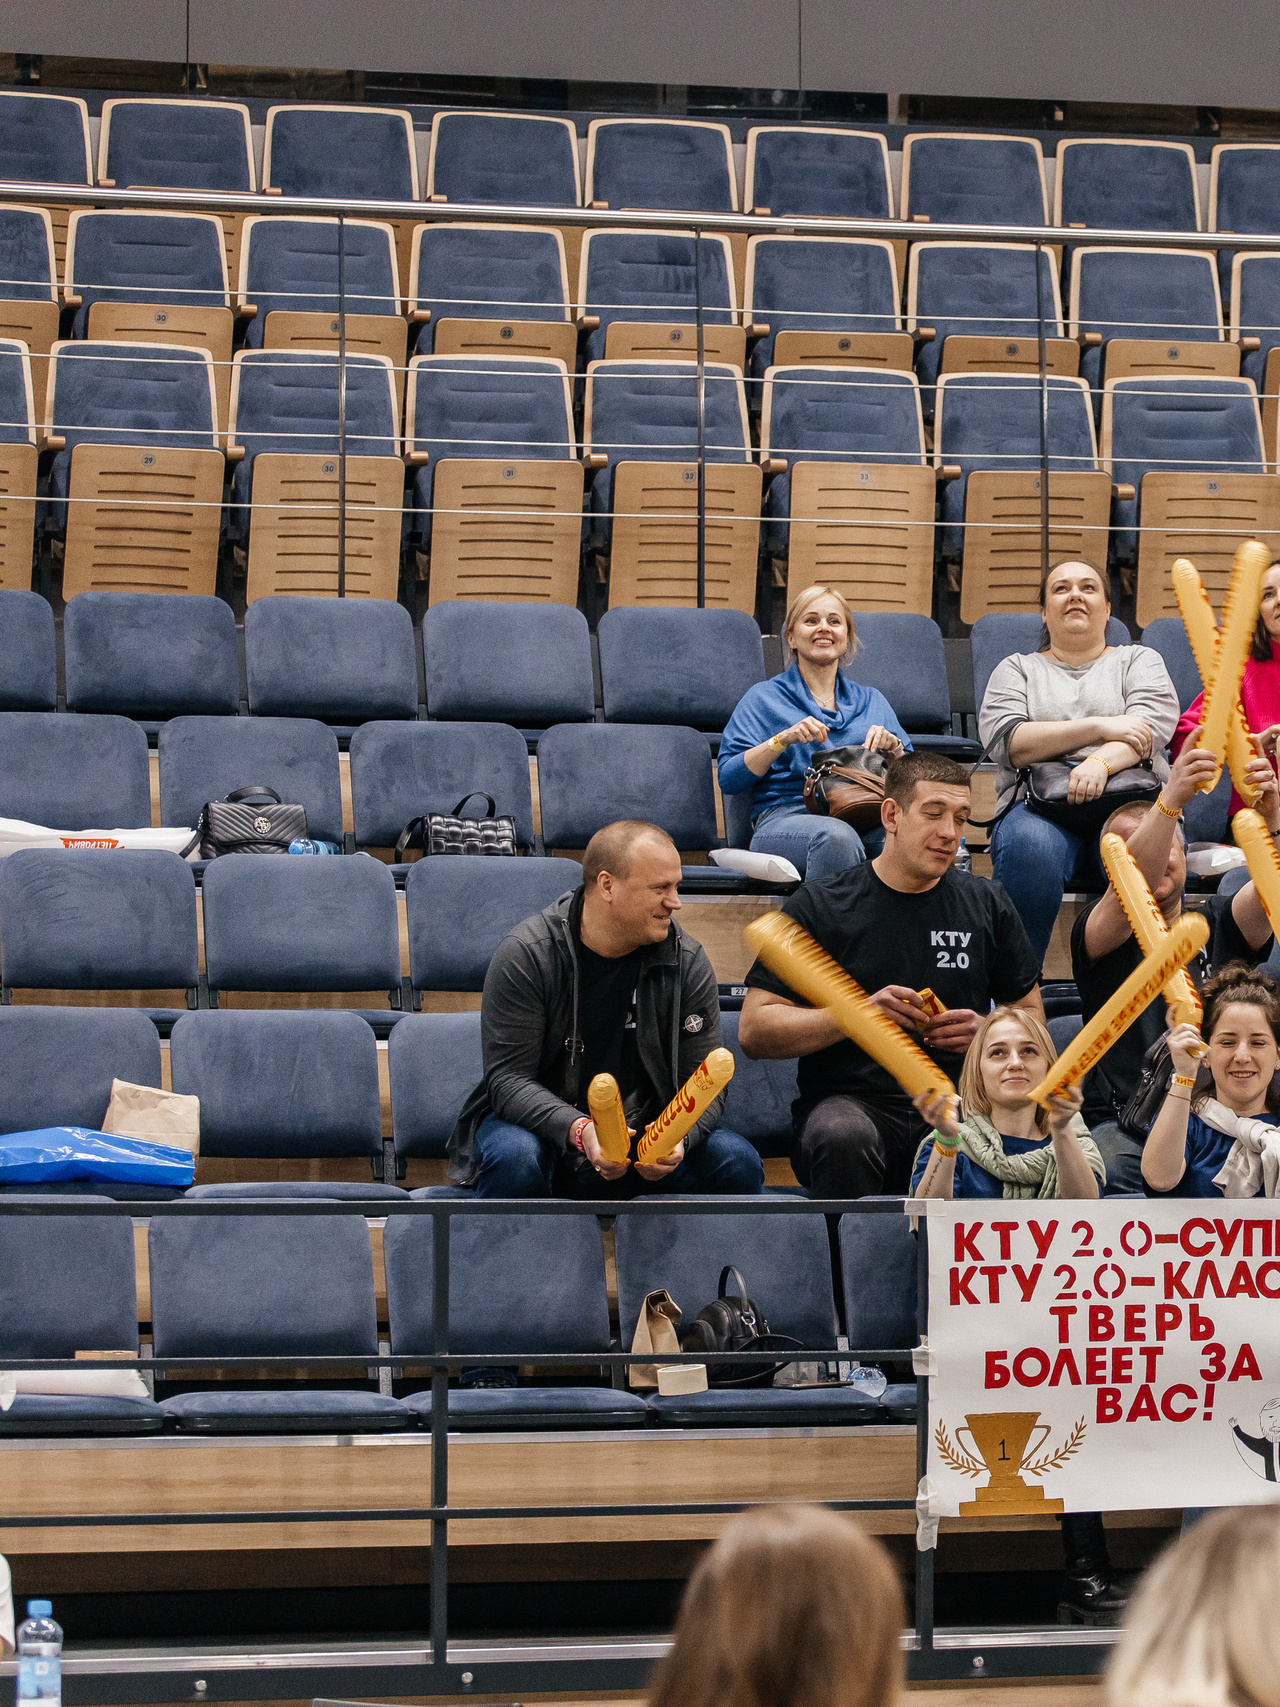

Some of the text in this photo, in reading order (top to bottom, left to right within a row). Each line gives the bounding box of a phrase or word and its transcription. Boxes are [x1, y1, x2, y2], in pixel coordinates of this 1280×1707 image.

[930, 930, 972, 947] КТУ
[936, 951, 970, 969] 2.0
[735, 987, 745, 995] 27
[954, 1220, 1059, 1262] КТУ
[949, 1263, 1044, 1305] КТУ
[1049, 1303, 1215, 1344] ТВЕРЬ
[984, 1343, 1263, 1389] БОЛЕЕТ ЗА
[1095, 1383, 1216, 1424] ВАС!
[997, 1439, 1012, 1461] 1
